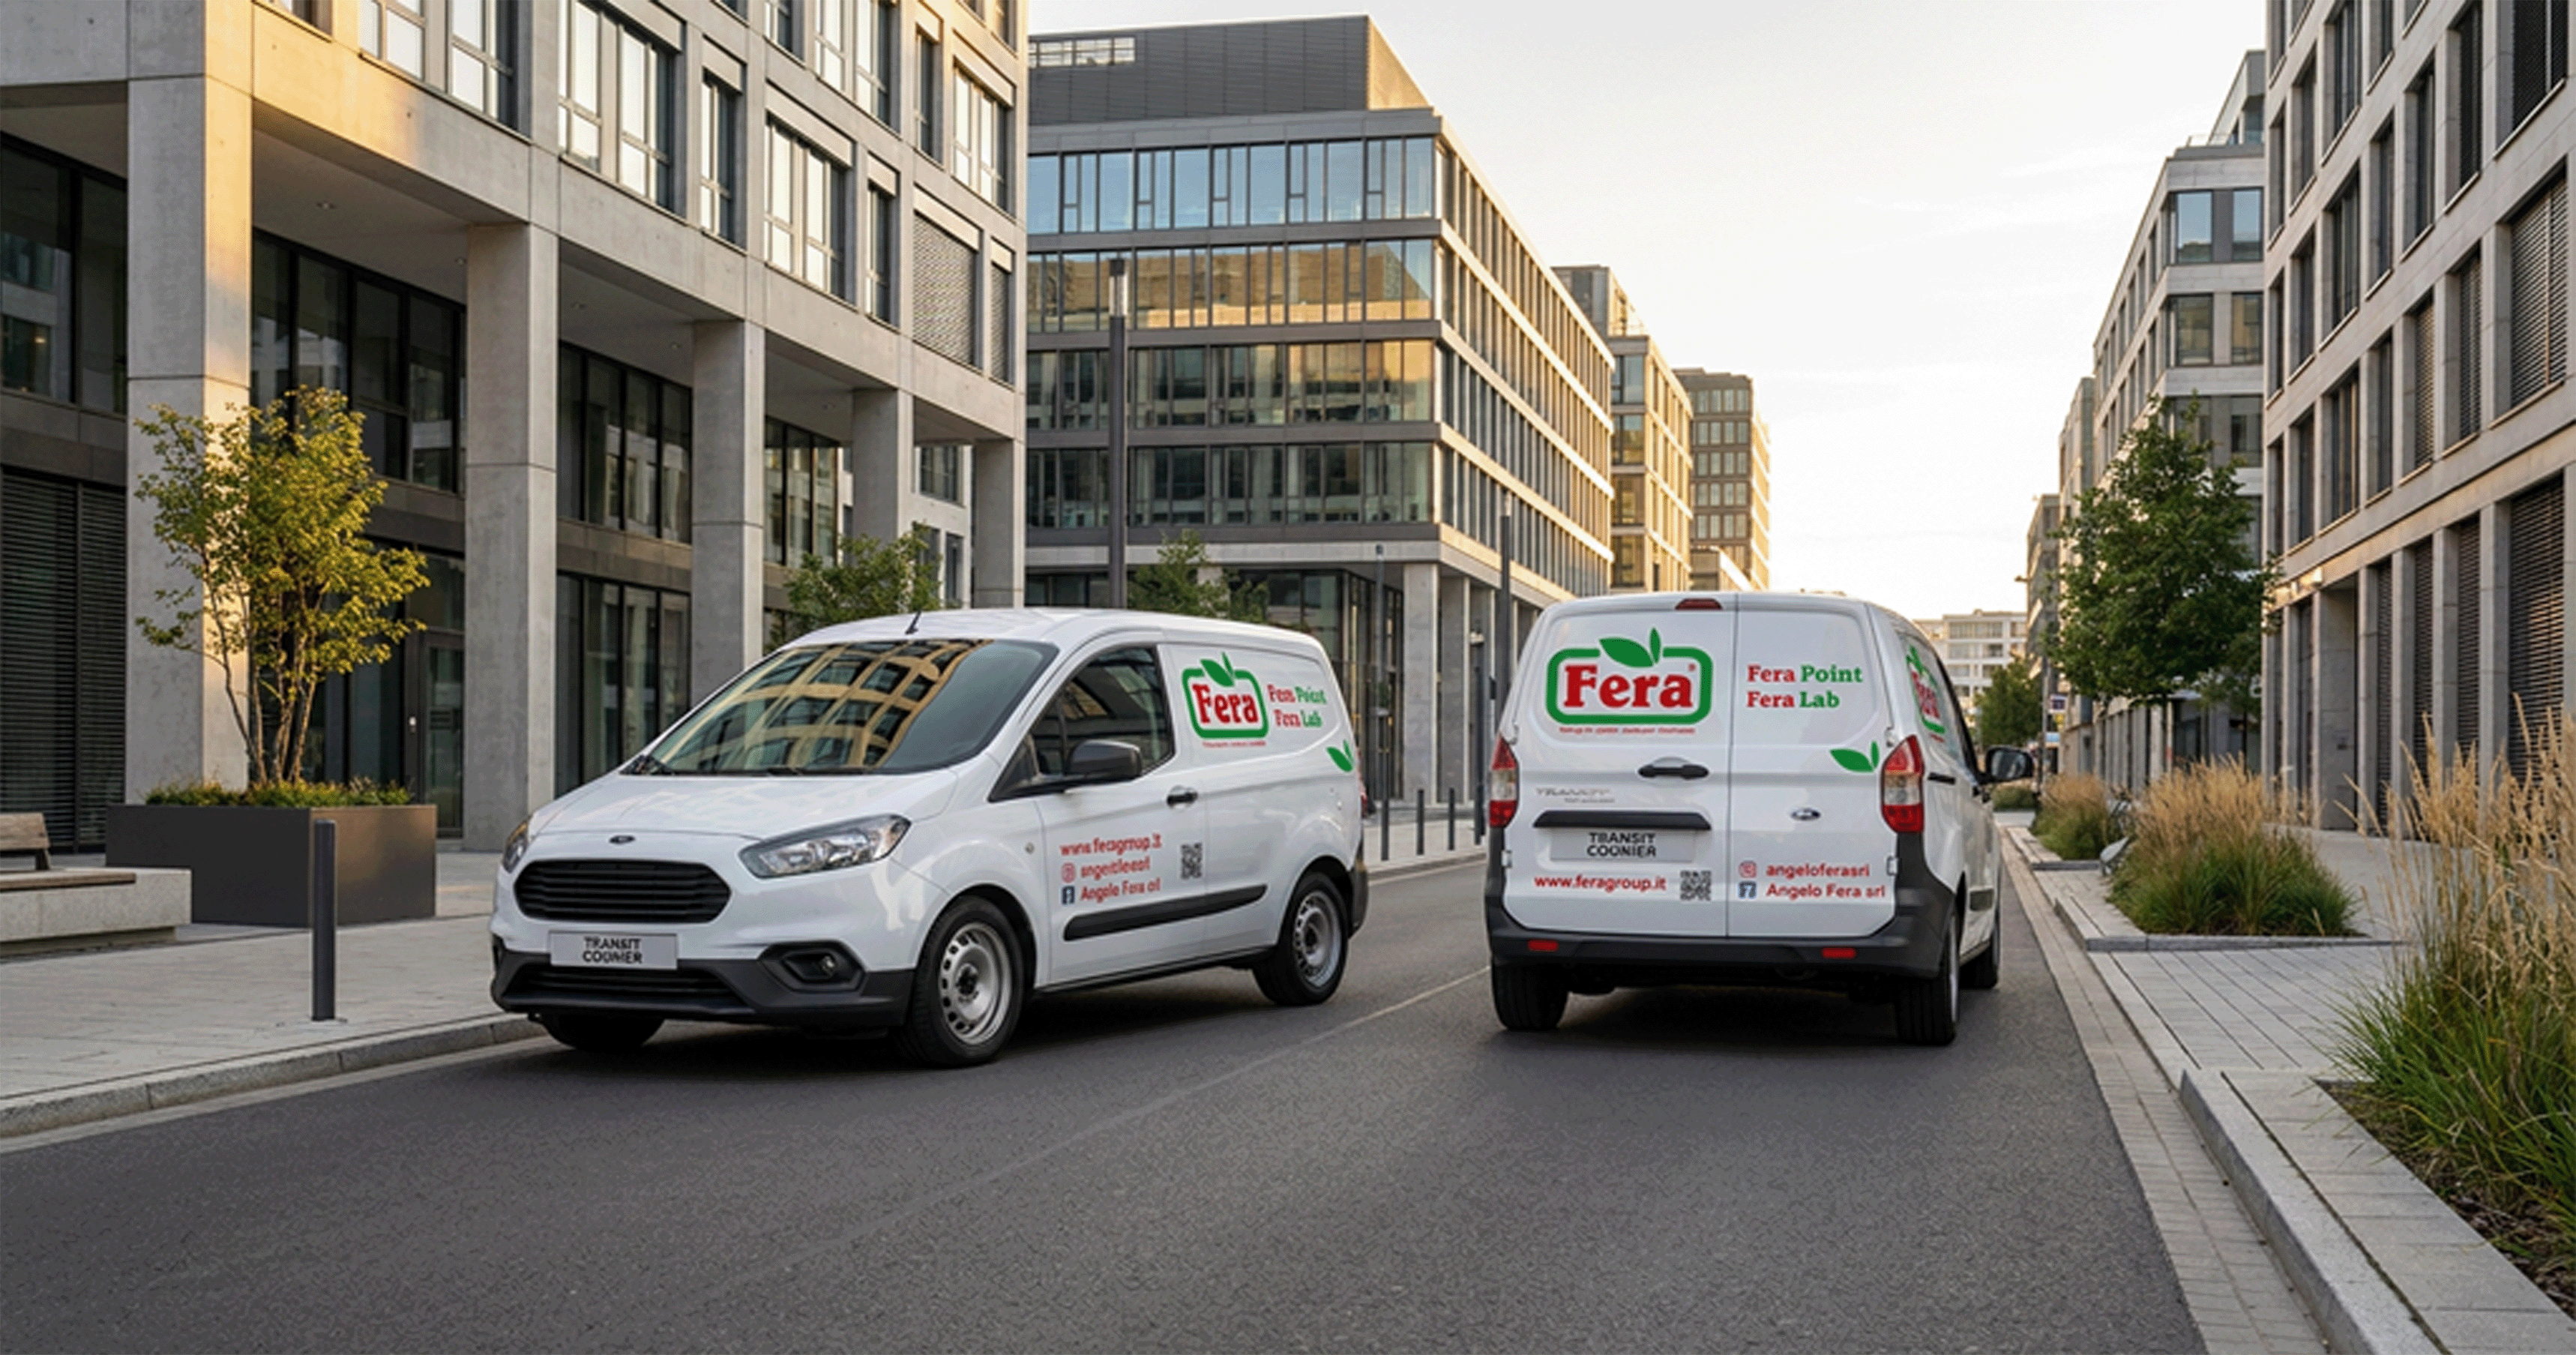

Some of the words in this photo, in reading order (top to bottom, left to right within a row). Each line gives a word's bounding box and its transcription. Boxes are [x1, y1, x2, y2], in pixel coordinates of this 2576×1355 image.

[1747, 664, 1796, 682] Fera
[1800, 664, 1863, 683] Point
[1563, 664, 1694, 709] Fera
[1192, 683, 1259, 724] Fera
[1747, 690, 1795, 708] Fera
[1799, 690, 1841, 708] Lab
[1534, 875, 1667, 892] www.feragroup.it
[1766, 883, 1822, 900] Angelo
[1826, 883, 1862, 898] Fera
[1865, 886, 1886, 898] srl
